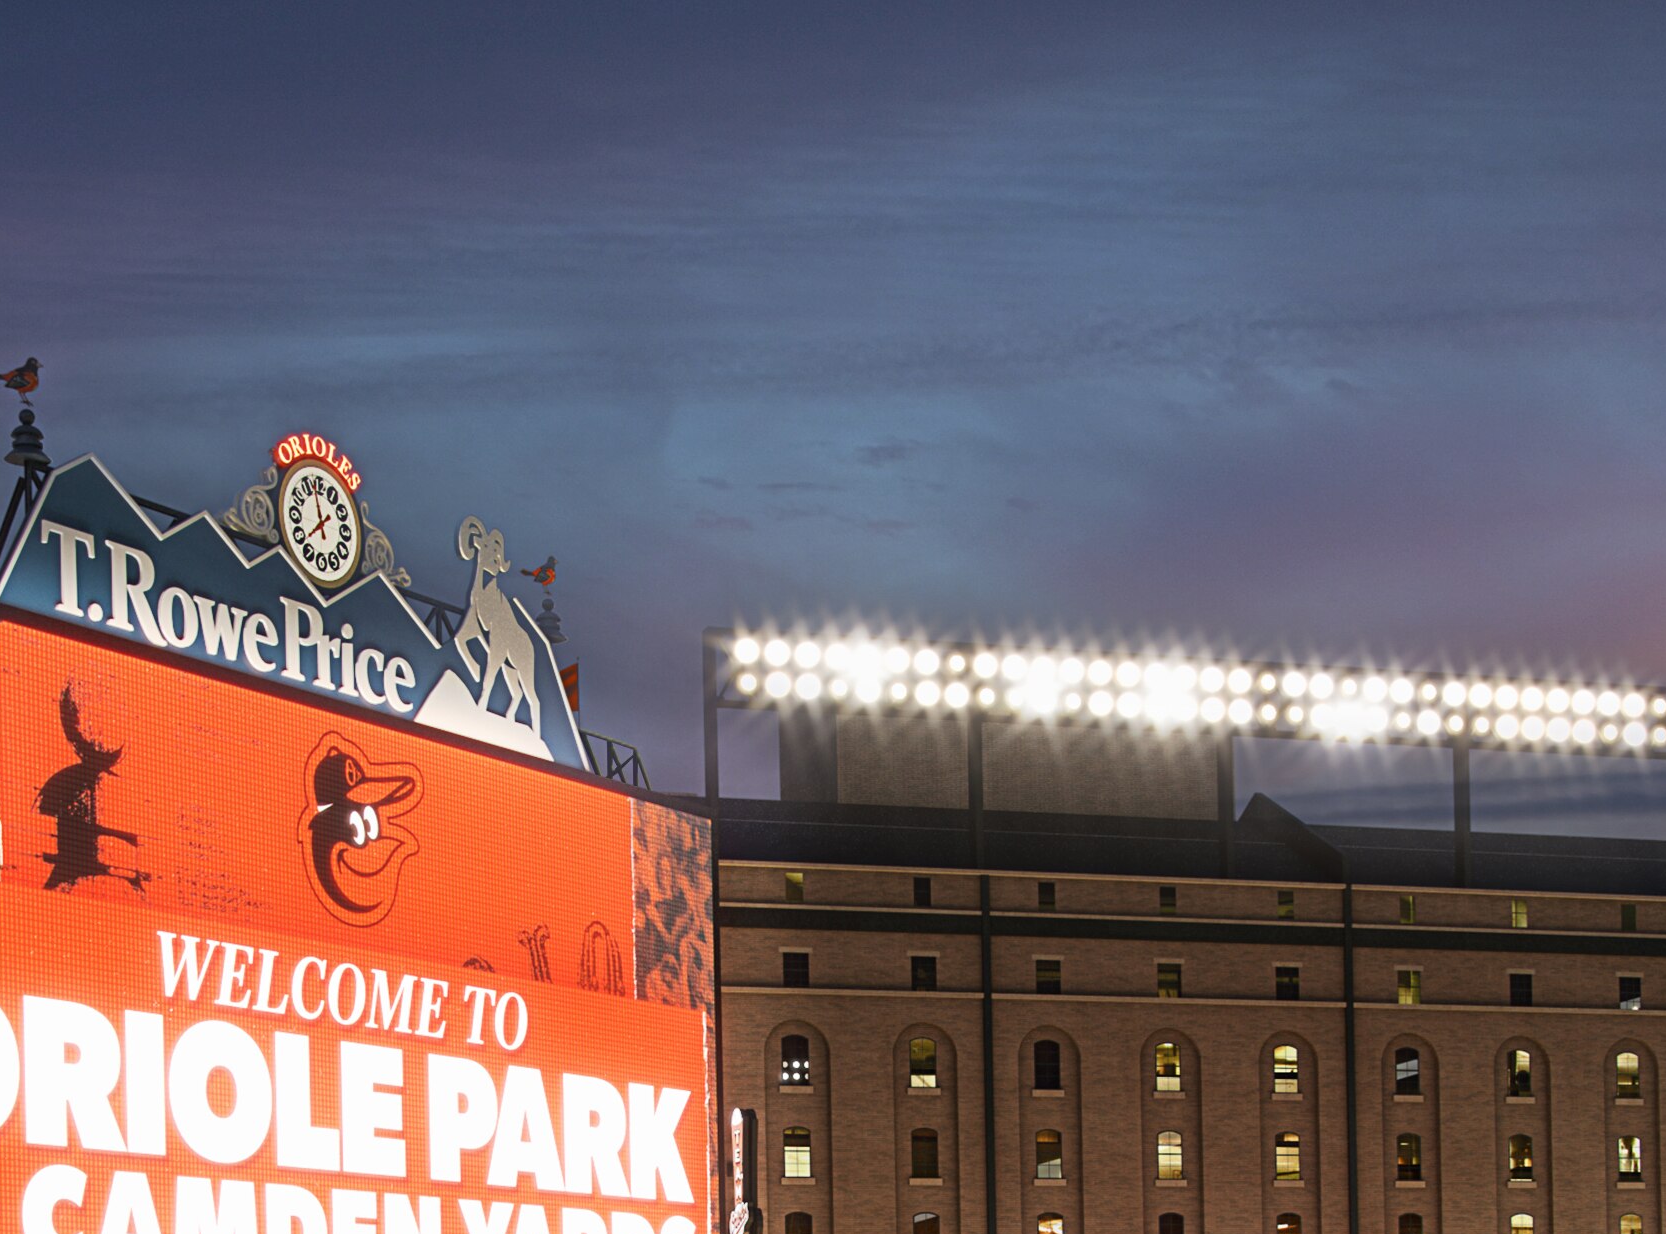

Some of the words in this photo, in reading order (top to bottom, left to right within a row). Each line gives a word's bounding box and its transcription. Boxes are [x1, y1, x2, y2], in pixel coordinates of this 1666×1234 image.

[278, 433, 361, 490] ORIOLES
[155, 929, 448, 1038] WELCOME
[463, 985, 529, 1050] TO
[427, 1053, 694, 1204] PARK
